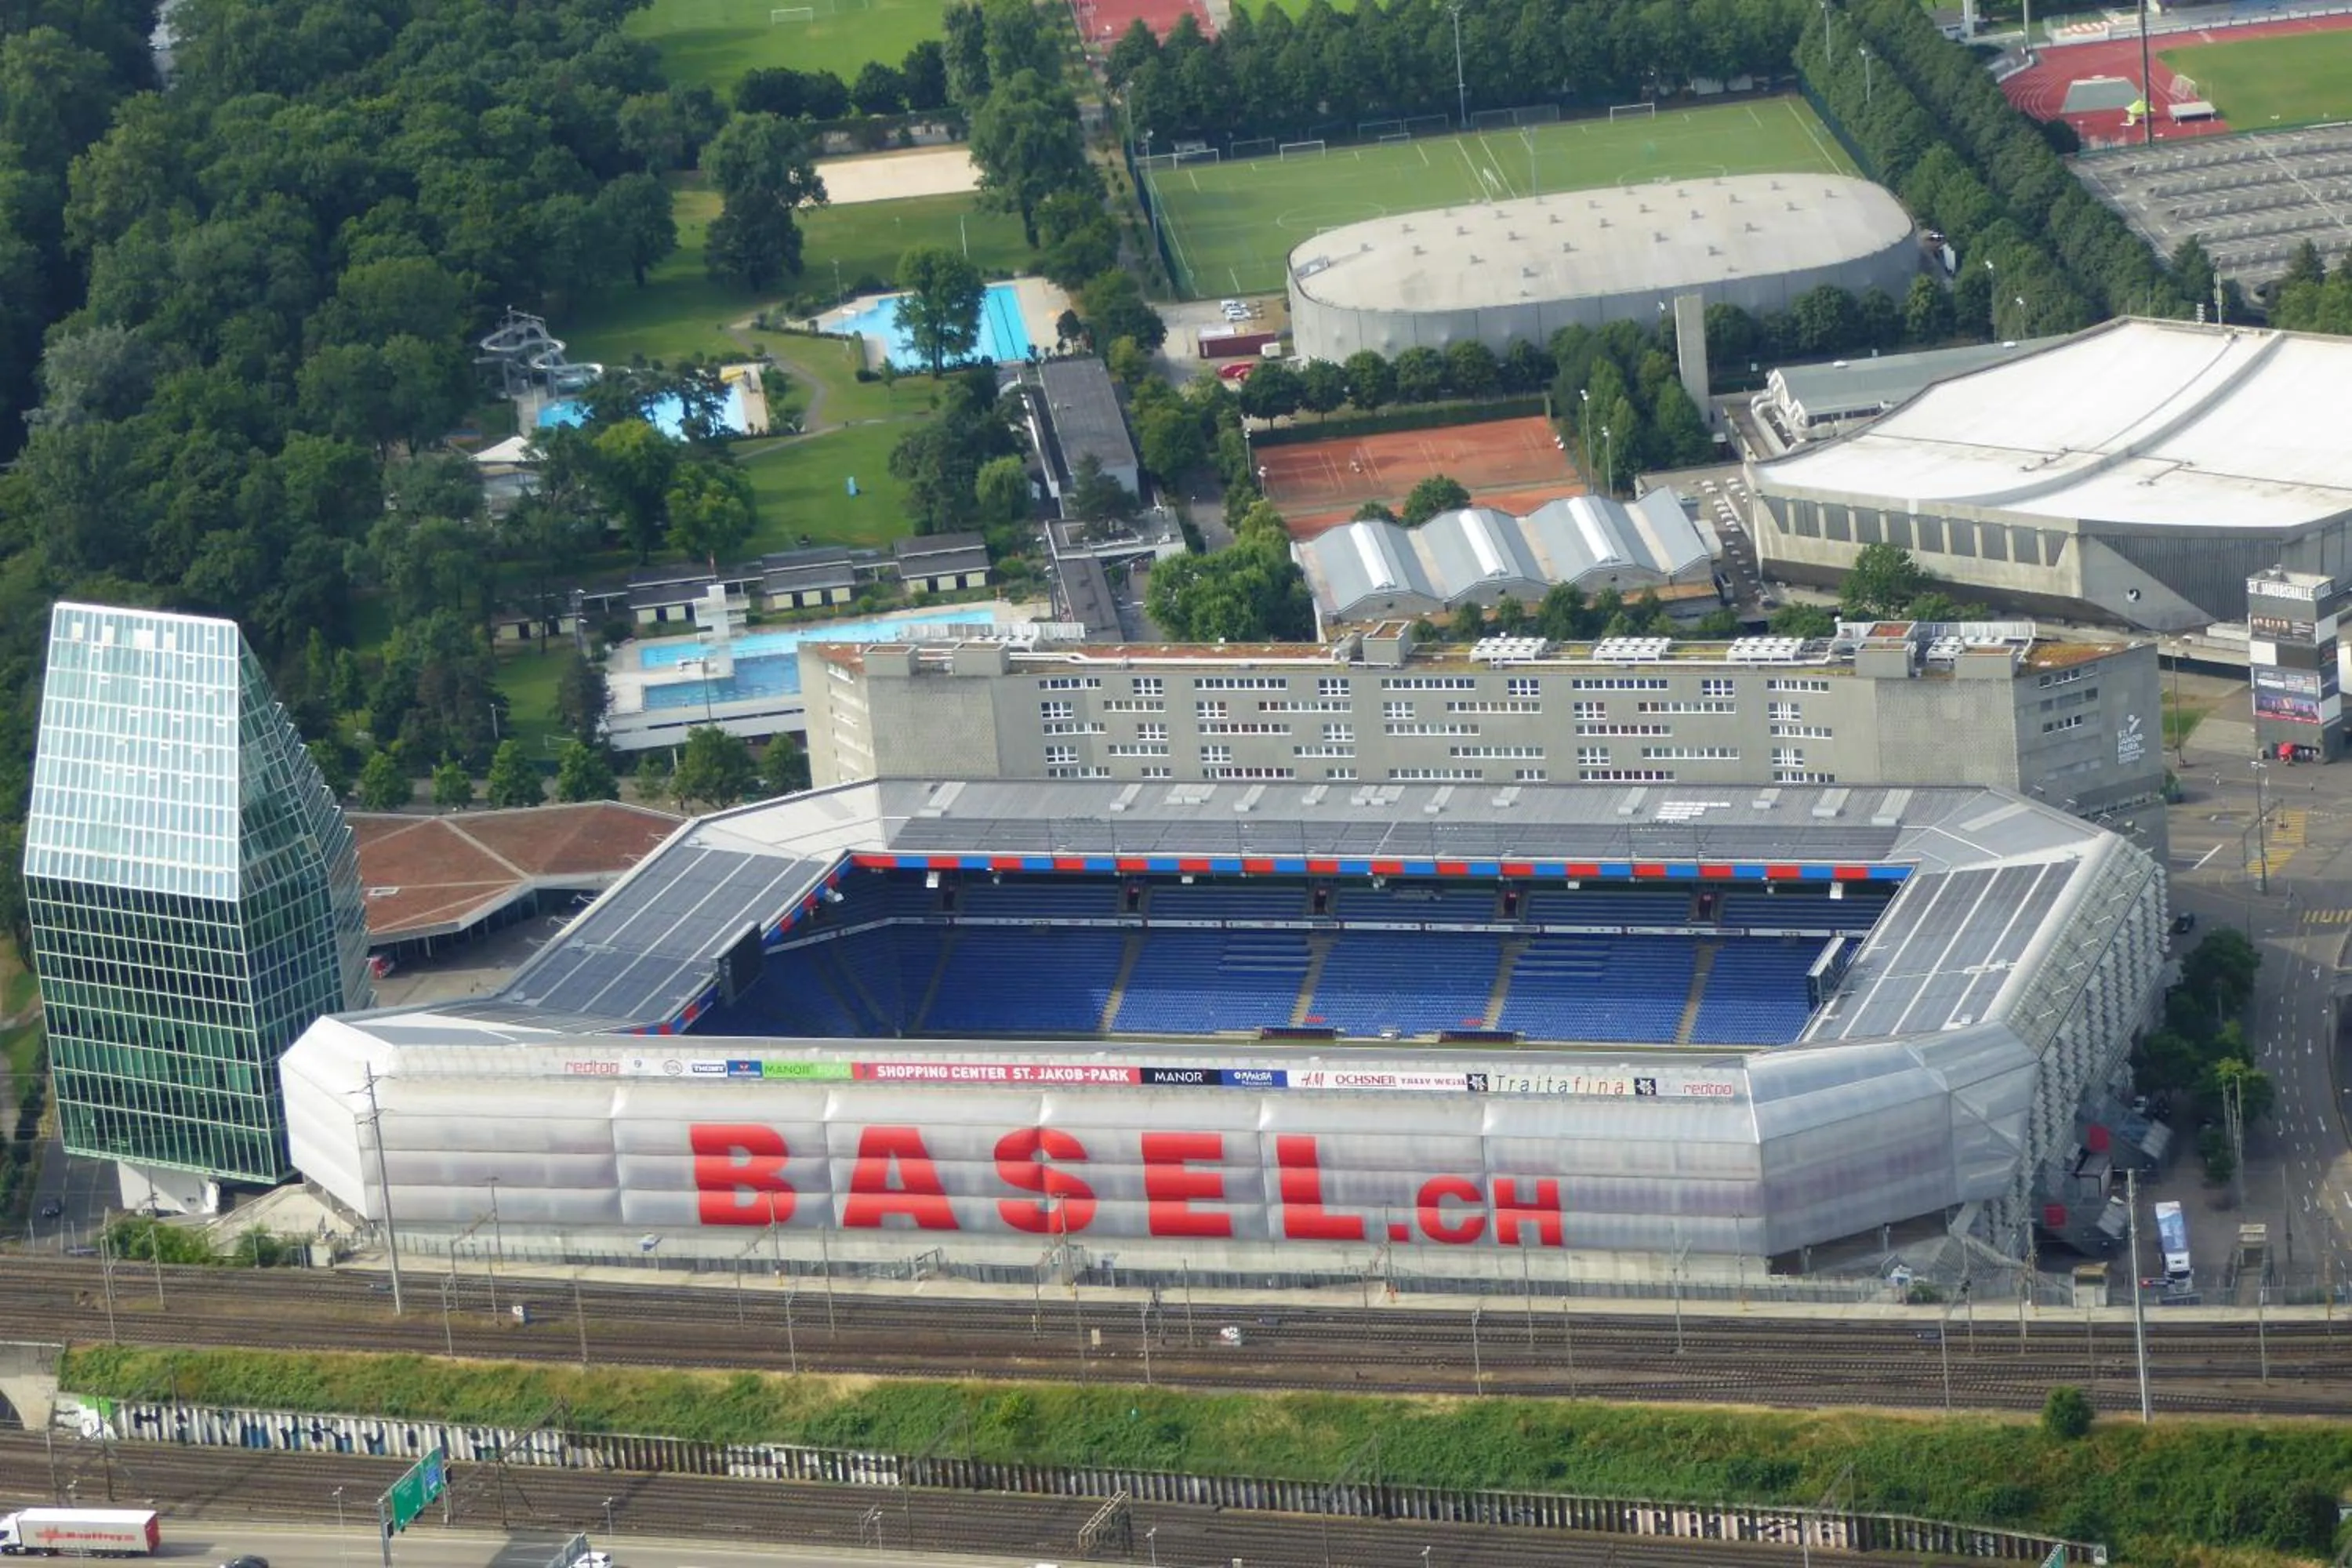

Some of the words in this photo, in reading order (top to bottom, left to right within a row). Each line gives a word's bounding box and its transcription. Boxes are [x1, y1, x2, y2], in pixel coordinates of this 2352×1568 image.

[764, 1064, 810, 1075] MANOR
[877, 1065, 948, 1078] SHOPPING
[951, 1067, 1006, 1080] CENTER
[1012, 1068, 1033, 1080] ST.
[1037, 1067, 1129, 1081] JAKOB-PARK
[1155, 1072, 1203, 1083] MANOR
[1335, 1075, 1396, 1085] OCHSNER
[1495, 1074, 1624, 1094] Traitafina
[690, 1123, 1563, 1247] BASEL.CH
